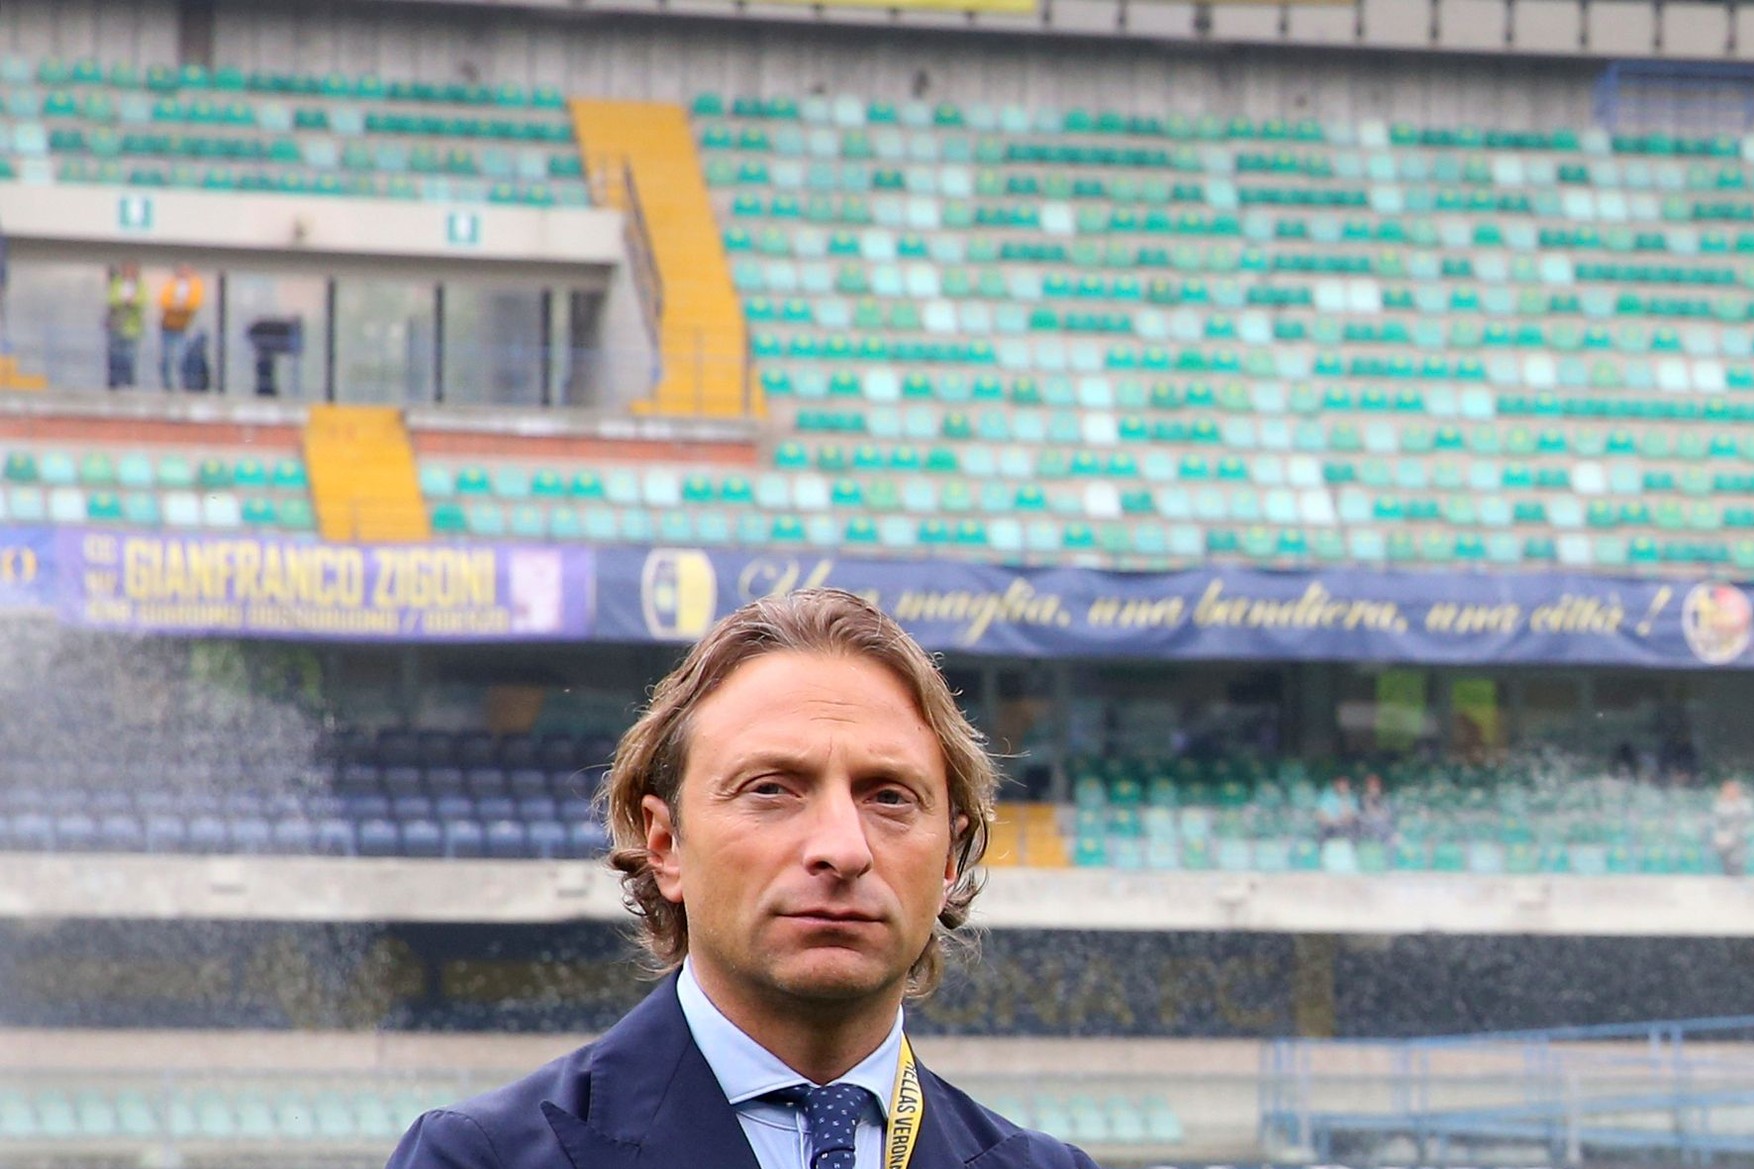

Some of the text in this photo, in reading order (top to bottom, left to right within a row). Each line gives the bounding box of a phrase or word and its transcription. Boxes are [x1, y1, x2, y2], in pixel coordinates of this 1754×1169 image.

[124, 538, 363, 606] GIANFRANCO
[373, 546, 496, 608] ZIGONI
[897, 1061, 918, 1113] HELLAS
